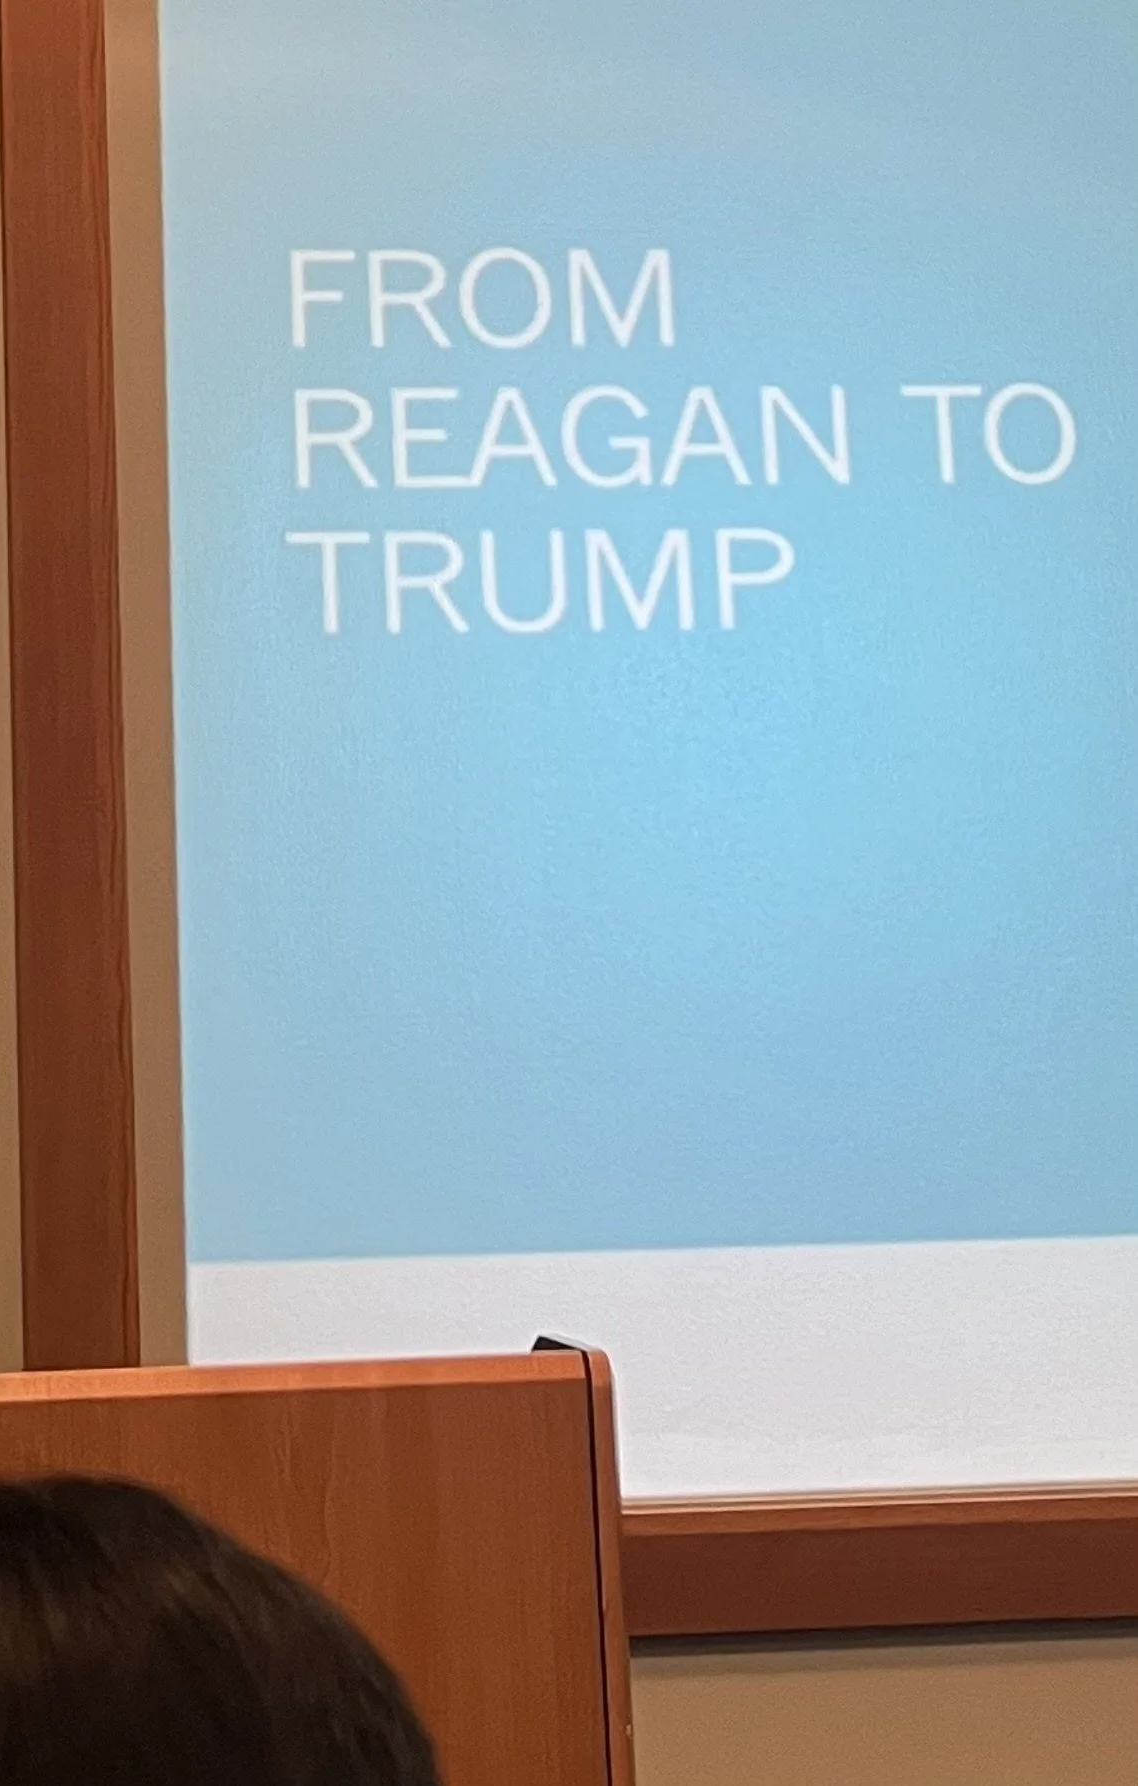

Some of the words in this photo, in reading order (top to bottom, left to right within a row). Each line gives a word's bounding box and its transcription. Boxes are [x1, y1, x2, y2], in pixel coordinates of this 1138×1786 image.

[289, 248, 675, 348] FROM
[294, 385, 851, 489] REAGAN
[900, 382, 1077, 485] TO
[285, 528, 796, 634] TRUMP
